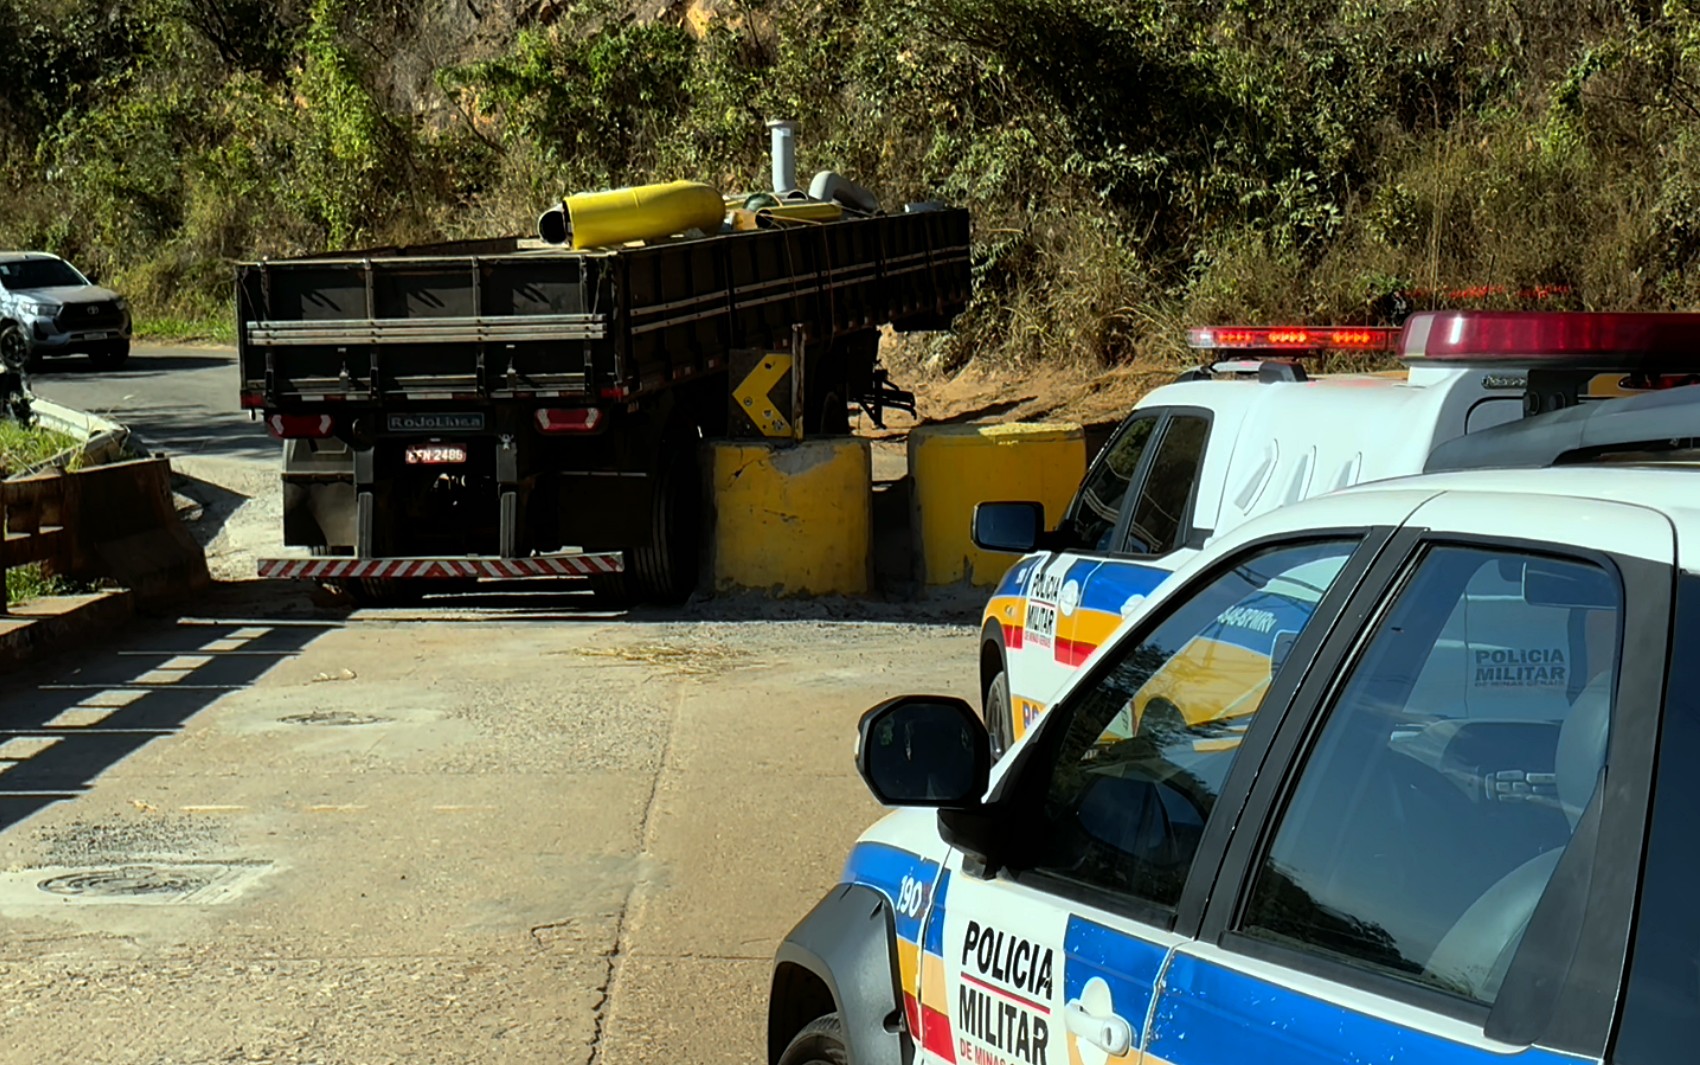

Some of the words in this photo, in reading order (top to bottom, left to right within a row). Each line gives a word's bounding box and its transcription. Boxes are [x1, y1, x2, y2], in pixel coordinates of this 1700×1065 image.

[1475, 648, 1565, 664] POLICIA
[1475, 666, 1566, 681] MILITAR
[896, 874, 922, 918] 190
[962, 920, 1053, 1000] POLICIA
[959, 984, 1049, 1065] MILITAR
[959, 1037, 972, 1061] DE
